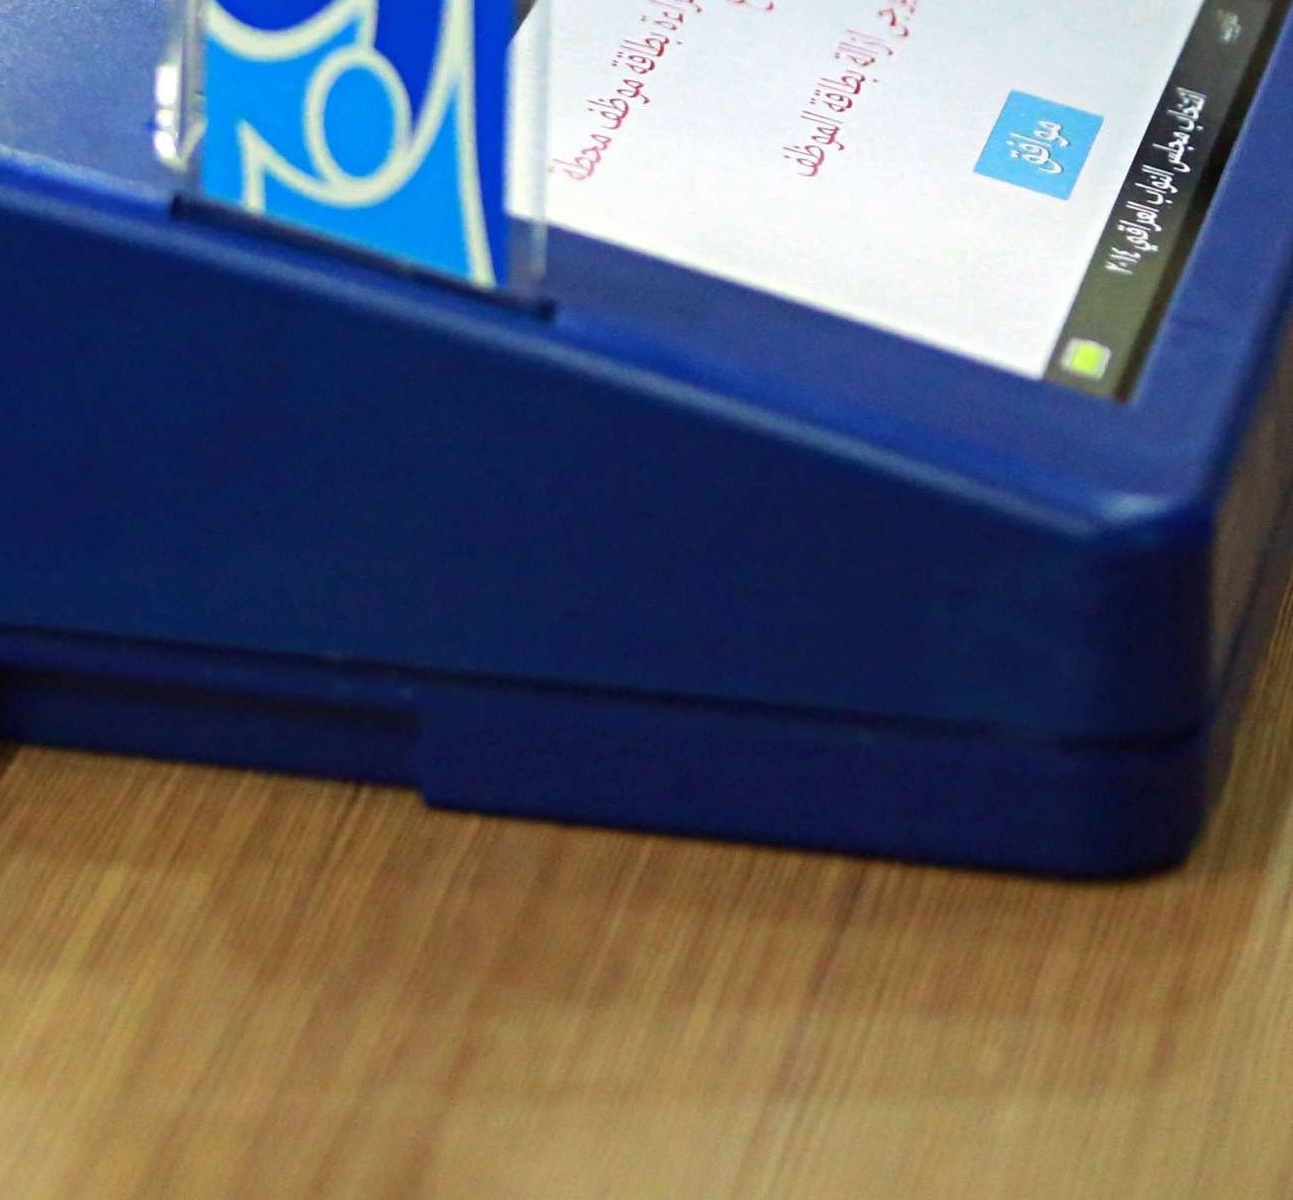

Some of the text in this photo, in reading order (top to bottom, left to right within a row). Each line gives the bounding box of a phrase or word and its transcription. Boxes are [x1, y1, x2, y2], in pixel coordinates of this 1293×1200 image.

[611, 32, 682, 74] بطاقة
[586, 79, 649, 130] موظف
[810, 70, 878, 112] بطاقة
[1167, 87, 1207, 131] انتخاب
[548, 134, 612, 180] محطة
[783, 111, 845, 177] الموظف
[1006, 120, 1071, 174] موافق
[1153, 131, 1194, 173] مجلس
[1135, 165, 1178, 205] النواب
[1117, 201, 1162, 251] العراقي
